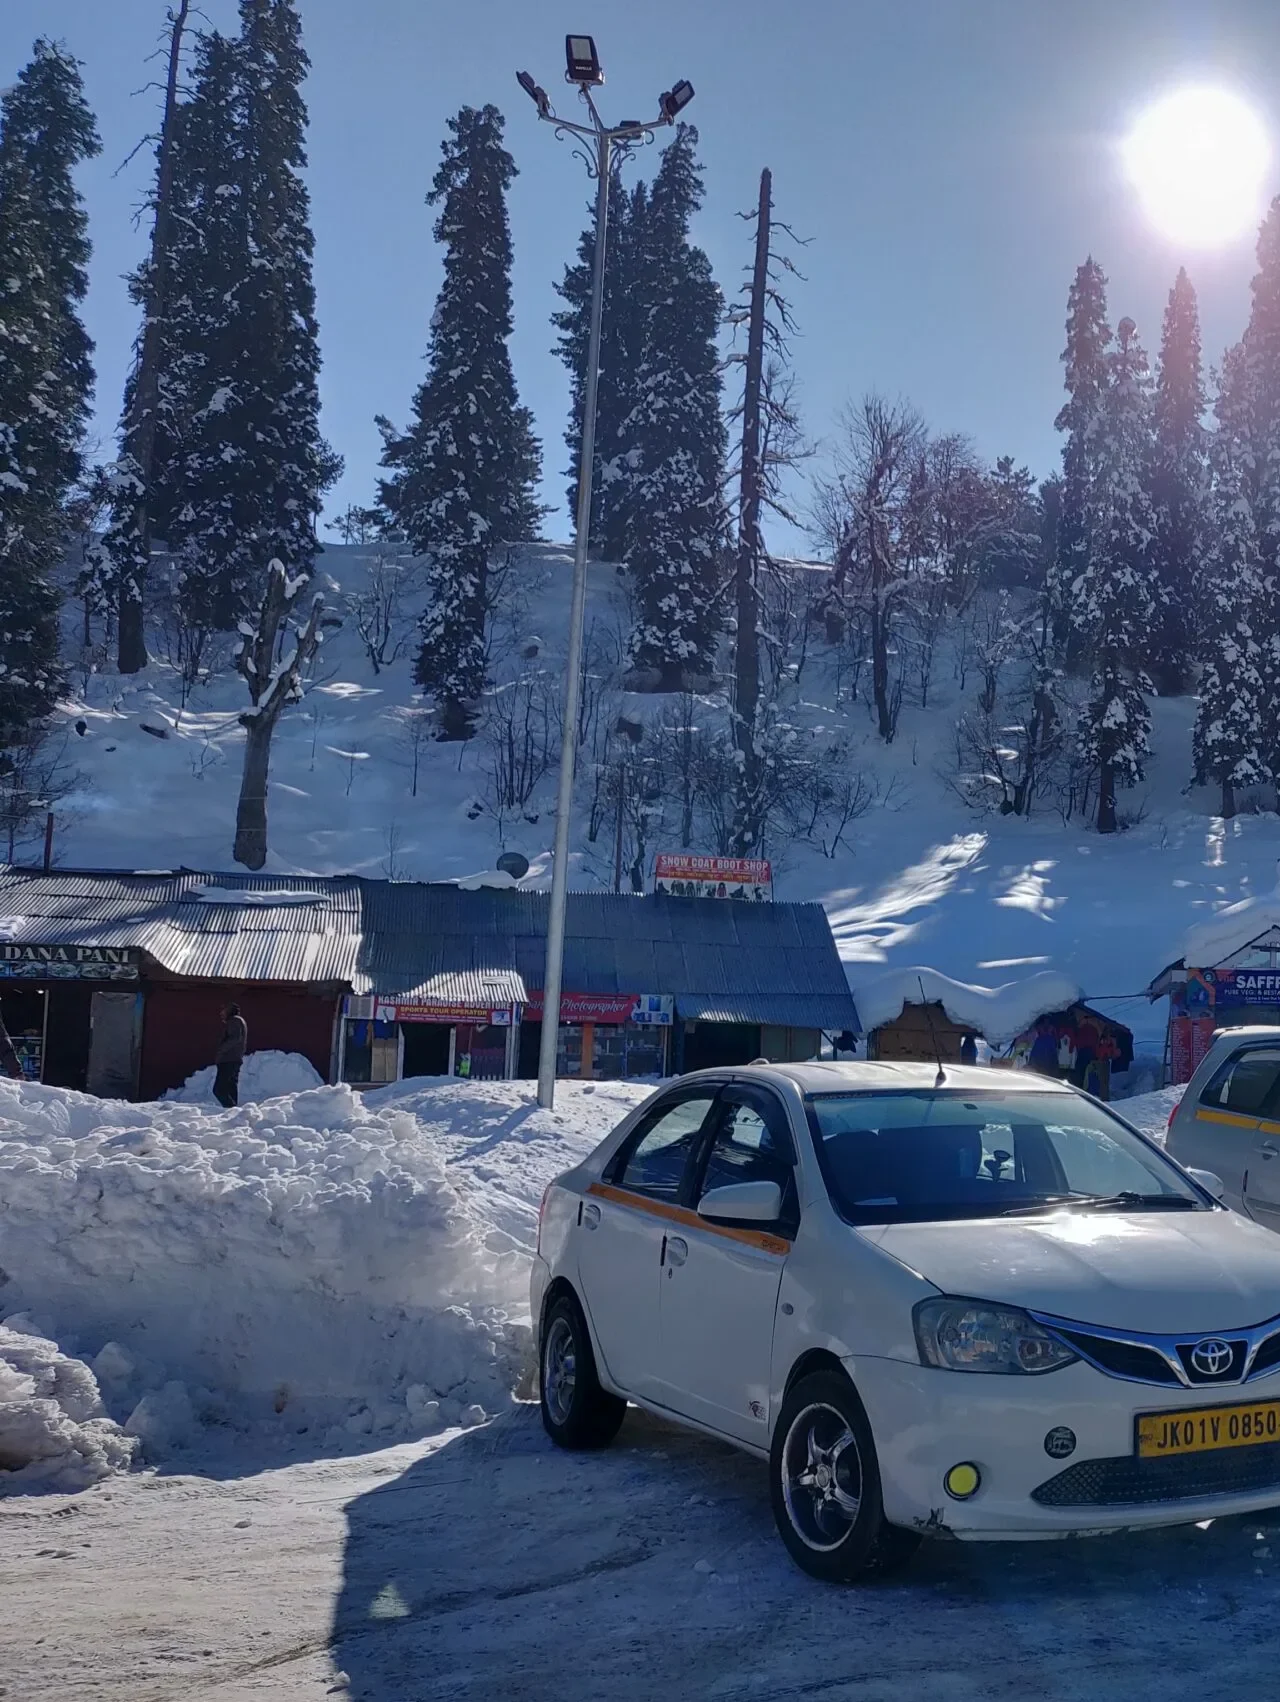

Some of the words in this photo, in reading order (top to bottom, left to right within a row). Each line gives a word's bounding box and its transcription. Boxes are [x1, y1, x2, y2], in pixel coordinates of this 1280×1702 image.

[661, 856, 688, 866] SNOW
[691, 857, 714, 868] COAT
[717, 859, 741, 870] BOOT
[743, 860, 768, 872] SHOP
[4, 946, 69, 960] DANA
[76, 948, 130, 963] PANI
[378, 995, 419, 1006] KASHMIR
[421, 998, 462, 1009] PARADISE
[464, 1001, 511, 1010] ADVENTURE
[560, 998, 628, 1016] Photographer
[1157, 1416, 1221, 1449] JK01V
[1229, 1410, 1277, 1440] 0850
